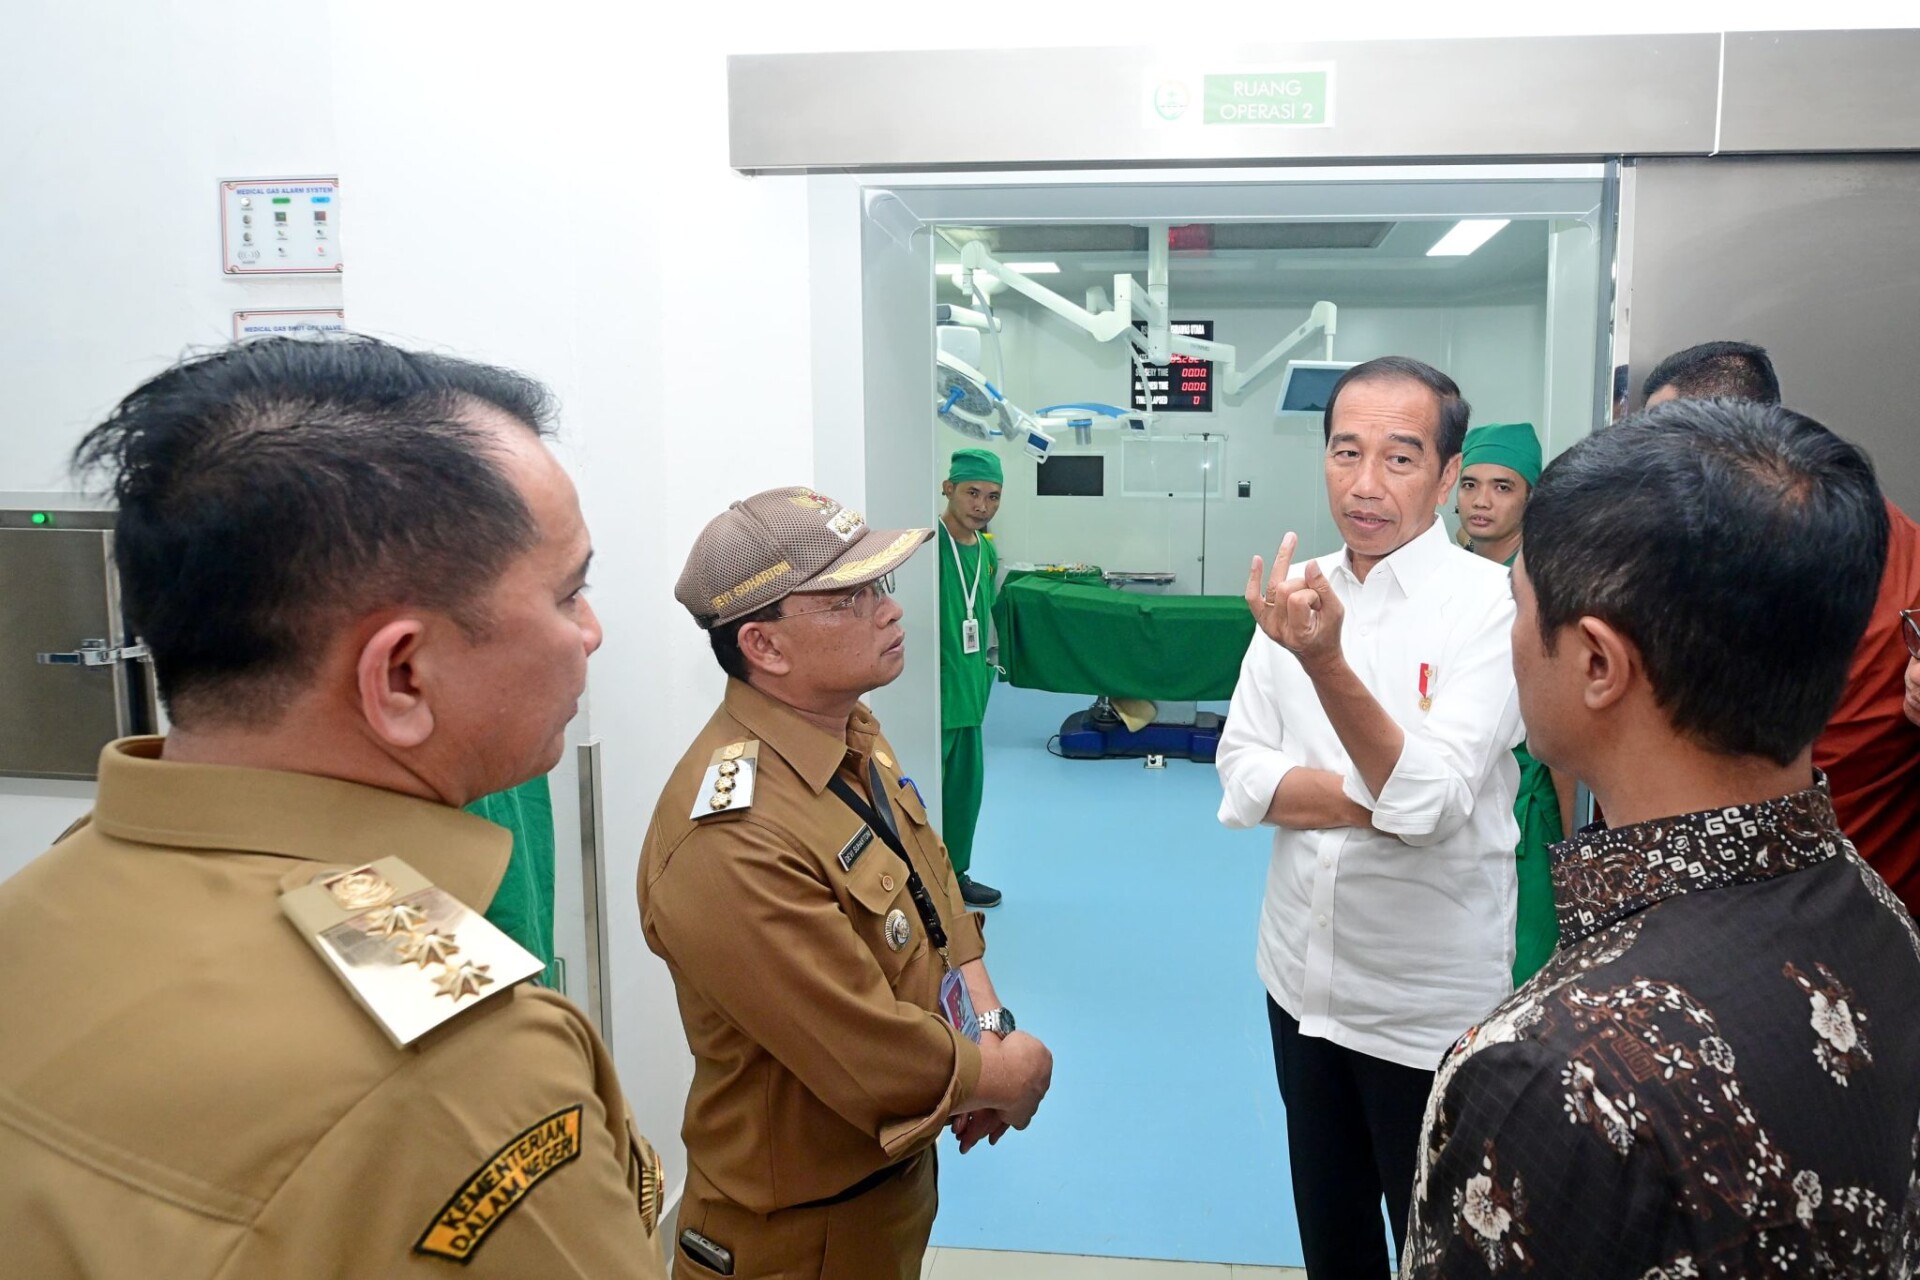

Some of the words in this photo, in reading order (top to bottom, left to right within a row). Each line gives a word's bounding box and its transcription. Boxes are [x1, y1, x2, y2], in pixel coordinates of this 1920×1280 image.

[1233, 79, 1302, 97] RUANG
[1219, 103, 1296, 120] OPERASI
[1302, 102, 1313, 119] 2
[734, 559, 791, 596] SUHARTONI
[441, 1115, 567, 1231] KEMENTERIAN
[449, 1177, 525, 1252] DALAM
[520, 1138, 573, 1179] NEGERI
